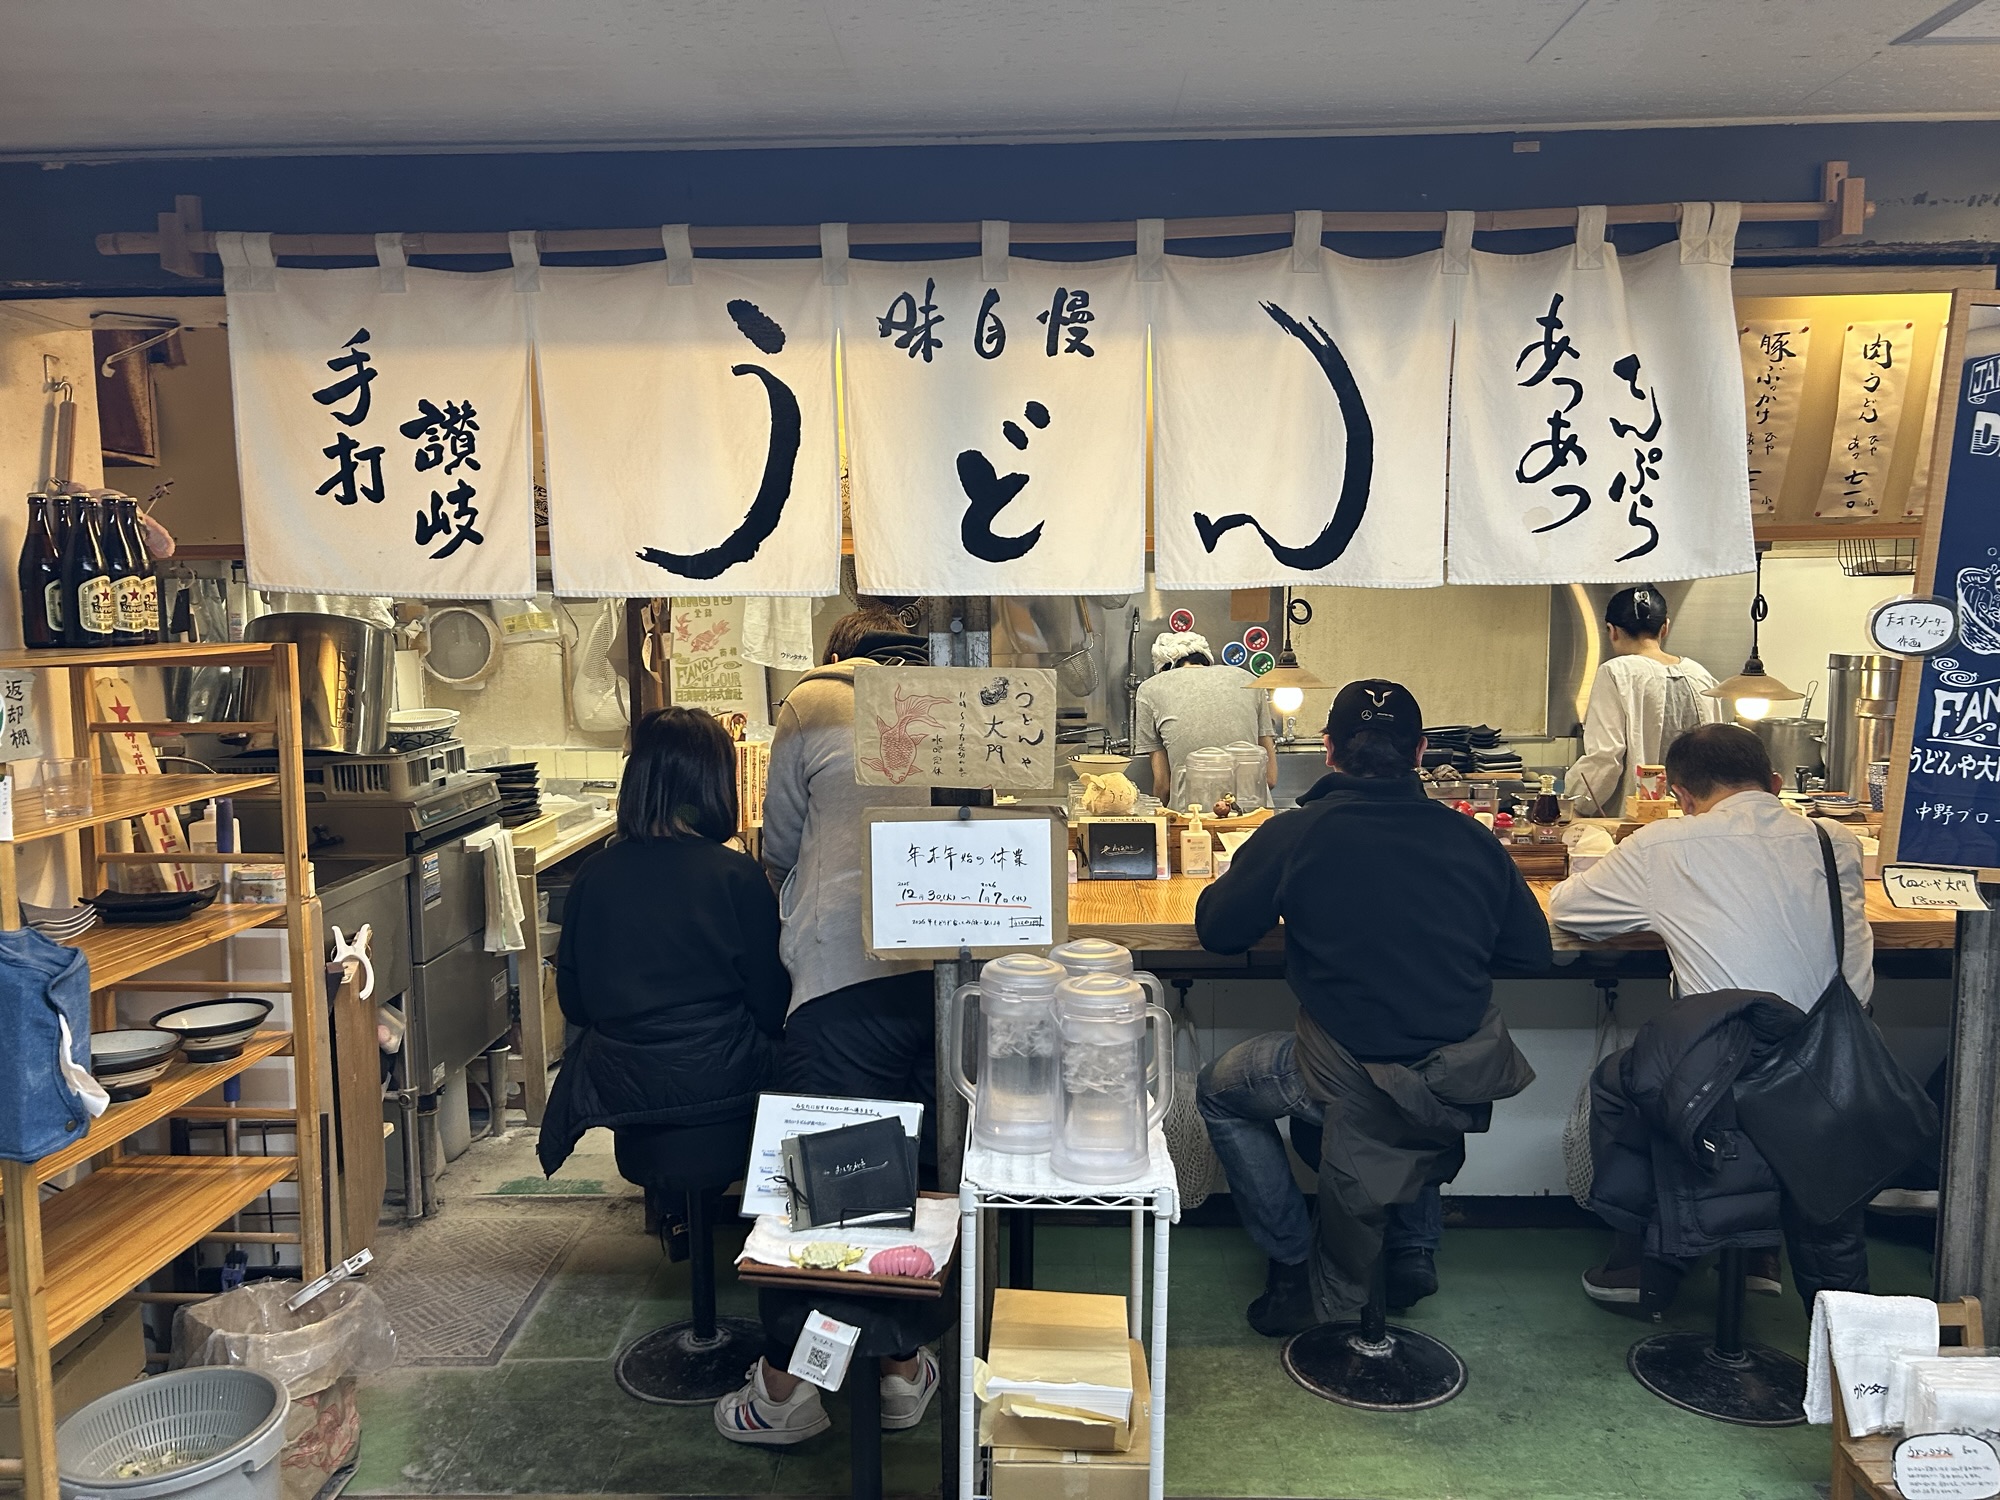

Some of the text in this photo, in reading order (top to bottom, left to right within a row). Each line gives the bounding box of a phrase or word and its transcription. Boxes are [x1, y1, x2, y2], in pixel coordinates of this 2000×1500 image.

[878, 278, 1094, 363] 味自慢
[1858, 333, 1893, 423] 肉うどん
[1973, 361, 2000, 394] JA
[312, 328, 386, 506] 手打
[1516, 293, 1592, 534] あつあつ
[675, 657, 719, 687] FANCY
[703, 672, 742, 688] FLOUR
[6, 680, 30, 748] 返却棚
[984, 715, 1008, 764] 大門
[1910, 746, 2000, 782] うどんや大
[907, 843, 1027, 871] 年末年始の休業
